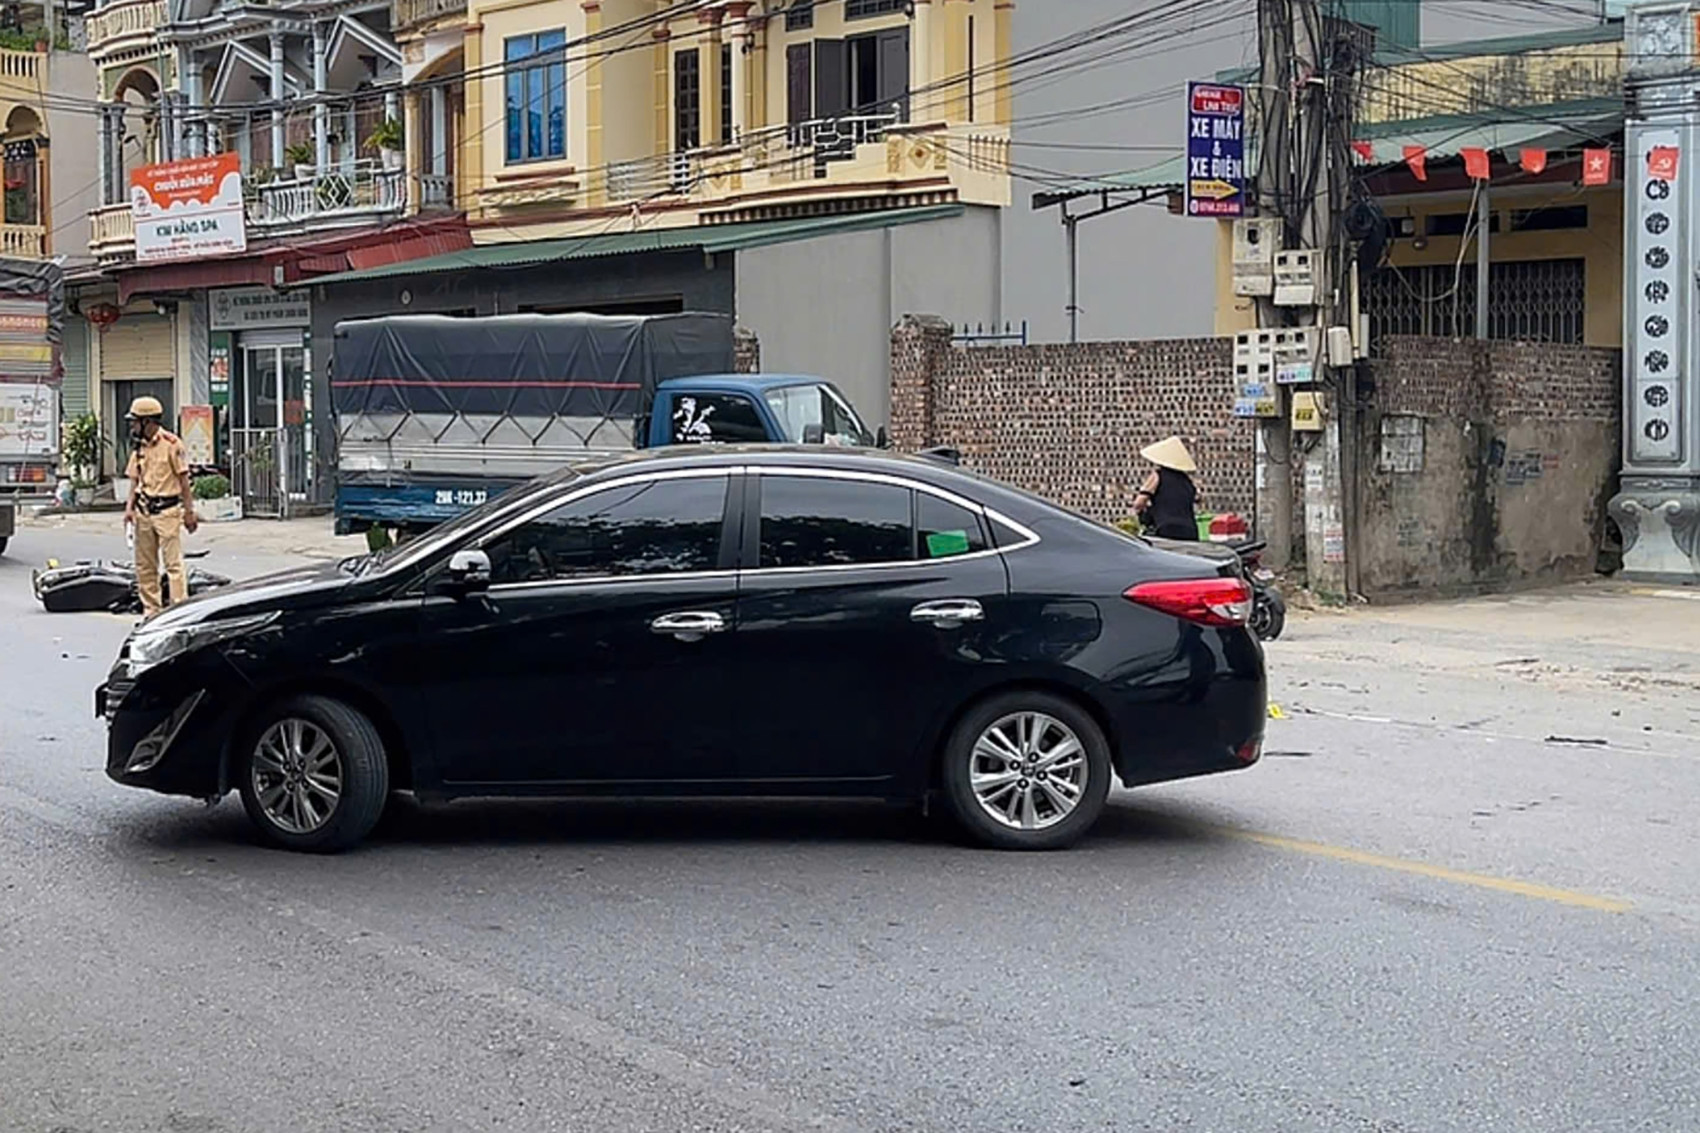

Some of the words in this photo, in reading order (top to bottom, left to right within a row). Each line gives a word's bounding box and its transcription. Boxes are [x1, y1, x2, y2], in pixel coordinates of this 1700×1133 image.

[1191, 117, 1210, 138] XE
[1213, 115, 1241, 139] MÁY
[1212, 141, 1221, 156] &
[1191, 157, 1210, 177] XE
[1212, 155, 1241, 182] ĐIỆN
[201, 219, 218, 232] SPA
